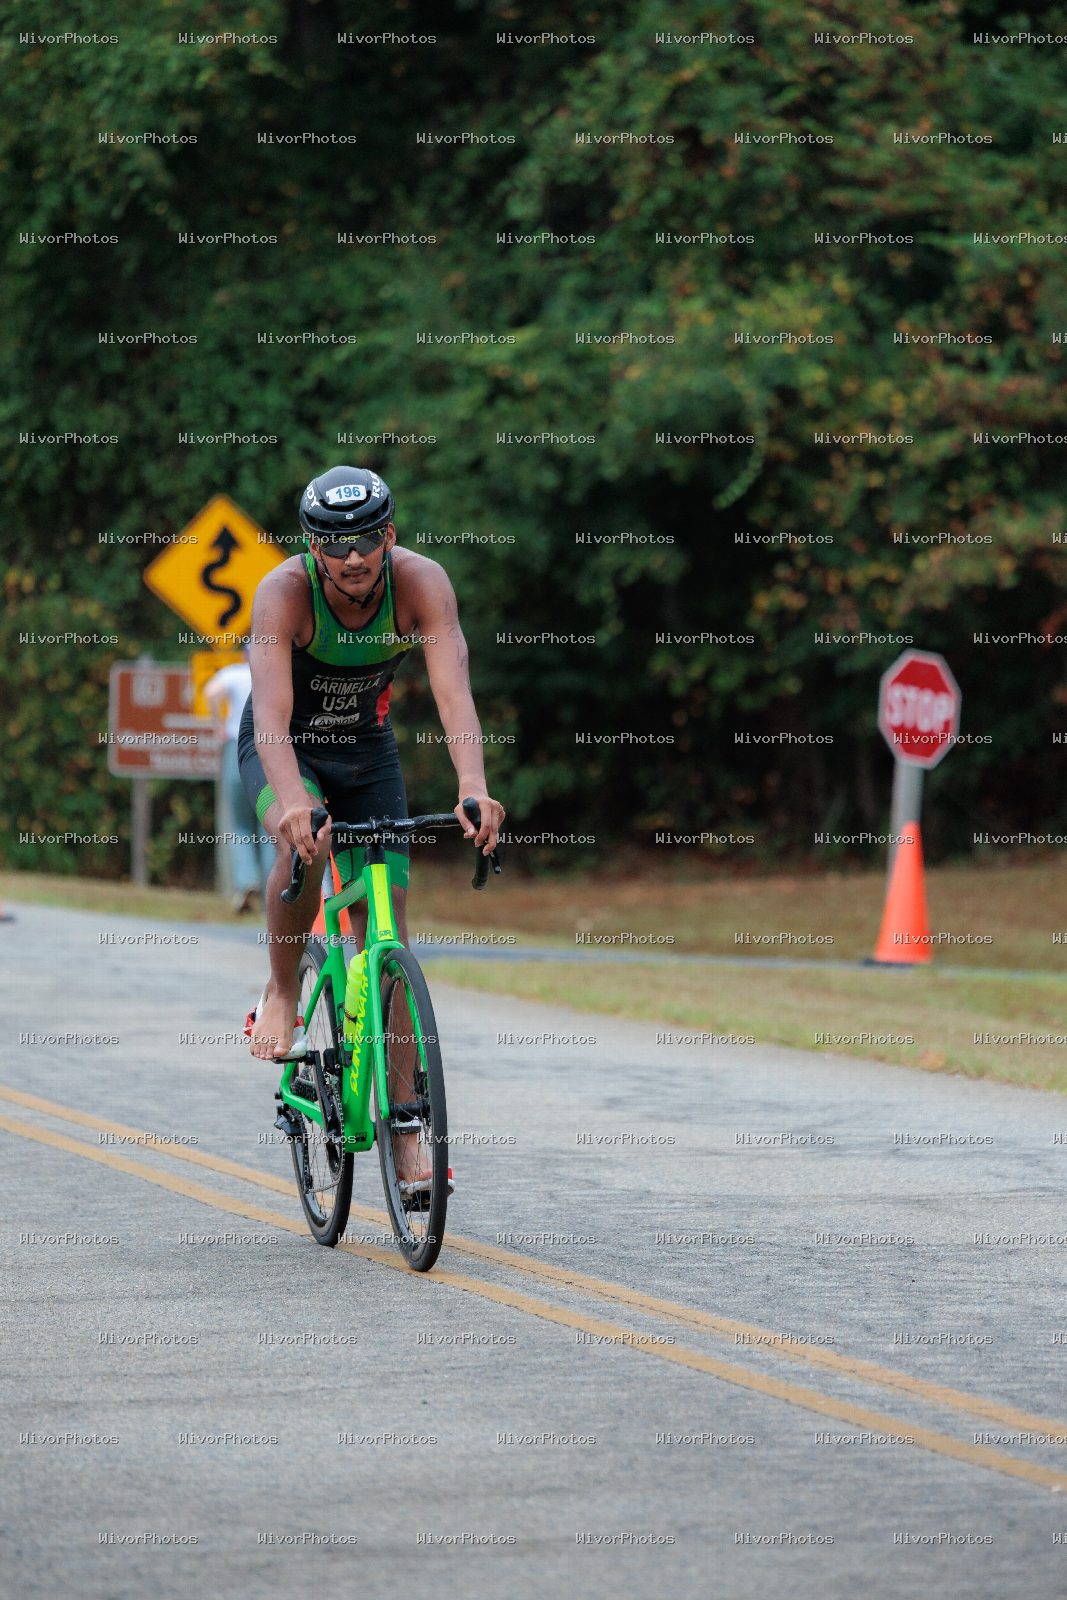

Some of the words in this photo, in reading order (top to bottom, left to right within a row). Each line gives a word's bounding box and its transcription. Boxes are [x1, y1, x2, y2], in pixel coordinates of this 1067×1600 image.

[336, 486, 361, 499] 196
[310, 677, 379, 695] GARIMELLA
[322, 694, 358, 711] USA
[886, 683, 955, 733] STOP
